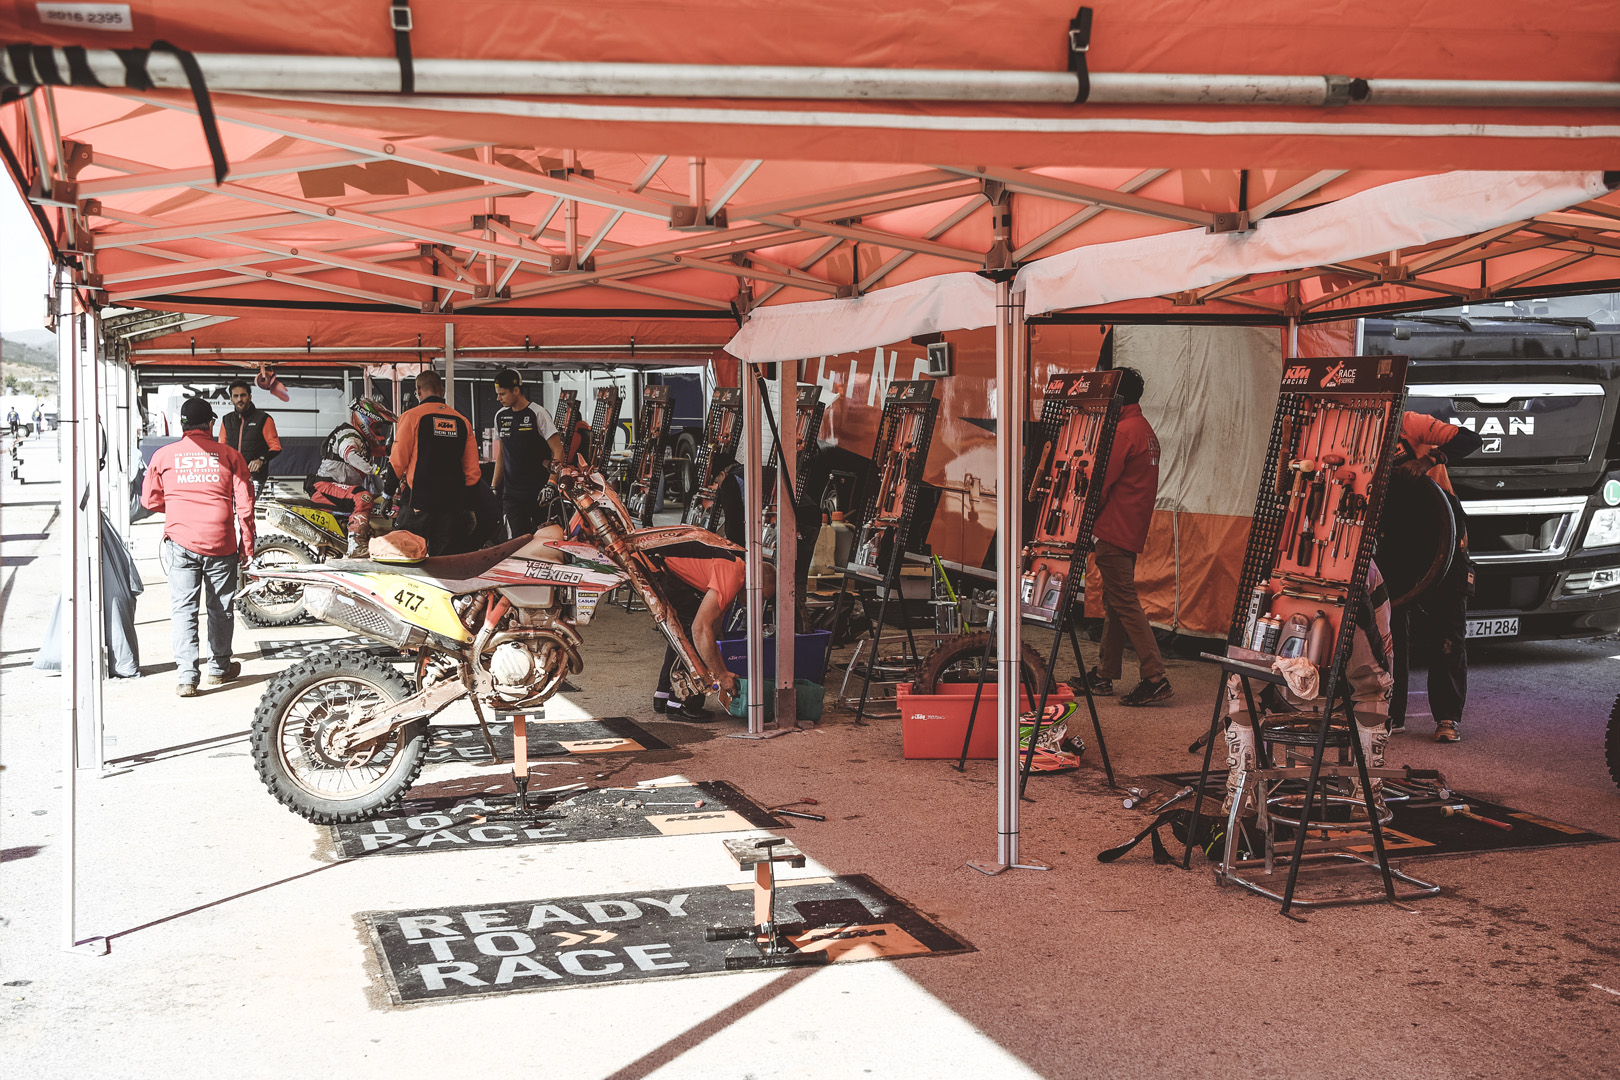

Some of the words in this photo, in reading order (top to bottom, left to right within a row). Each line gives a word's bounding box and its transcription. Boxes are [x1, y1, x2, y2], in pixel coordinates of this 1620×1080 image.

[87, 11, 123, 24] 2395
[1284, 365, 1311, 379] KTM
[1338, 368, 1357, 378] RACE
[1048, 379, 1065, 390] KTM
[1449, 416, 1535, 436] MAN
[310, 513, 326, 526] 473
[526, 560, 554, 571] TEAM
[525, 567, 584, 584] MEXICO
[394, 589, 426, 612] 477
[1475, 621, 1493, 636] ZH
[1494, 619, 1518, 635] 284
[360, 825, 569, 851] RACE
[396, 893, 690, 940] READY
[407, 931, 537, 962] TO
[417, 942, 691, 991] RACE
